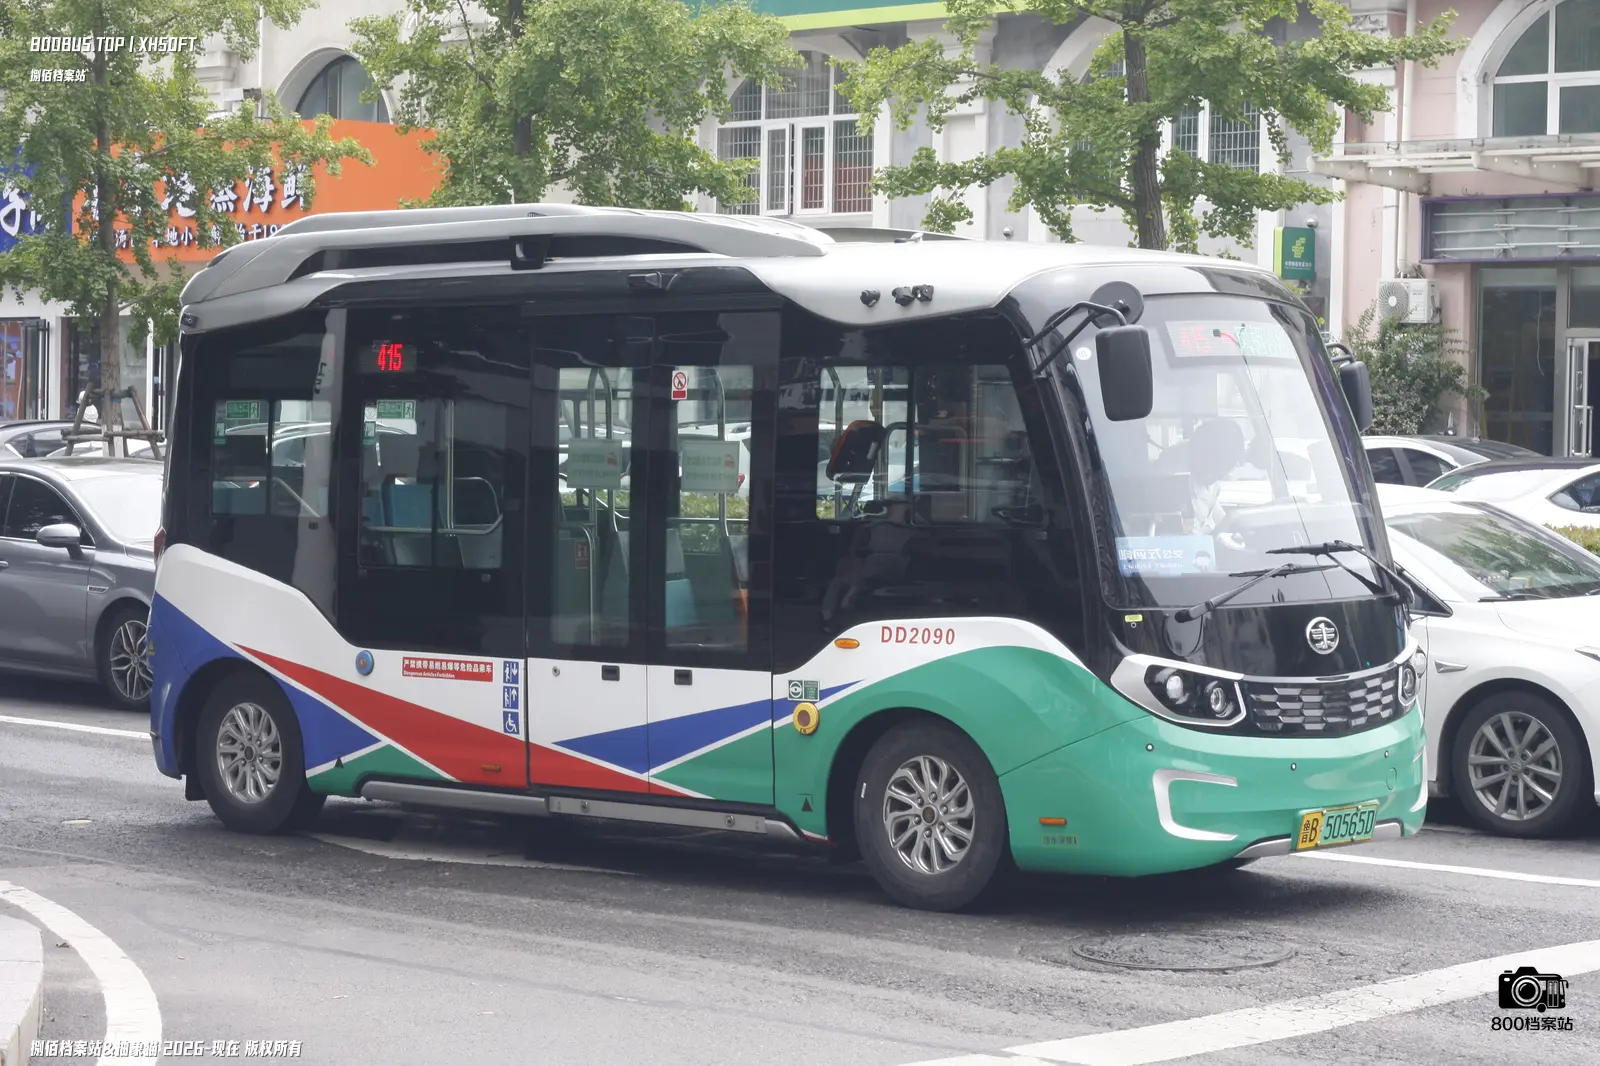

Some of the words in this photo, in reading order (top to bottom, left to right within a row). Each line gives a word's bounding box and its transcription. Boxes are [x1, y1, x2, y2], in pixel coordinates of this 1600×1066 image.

[377, 343, 403, 371] 415
[880, 625, 957, 646] DD2090
[403, 659, 492, 673] 严禁携带易燃易爆等危险品乘车
